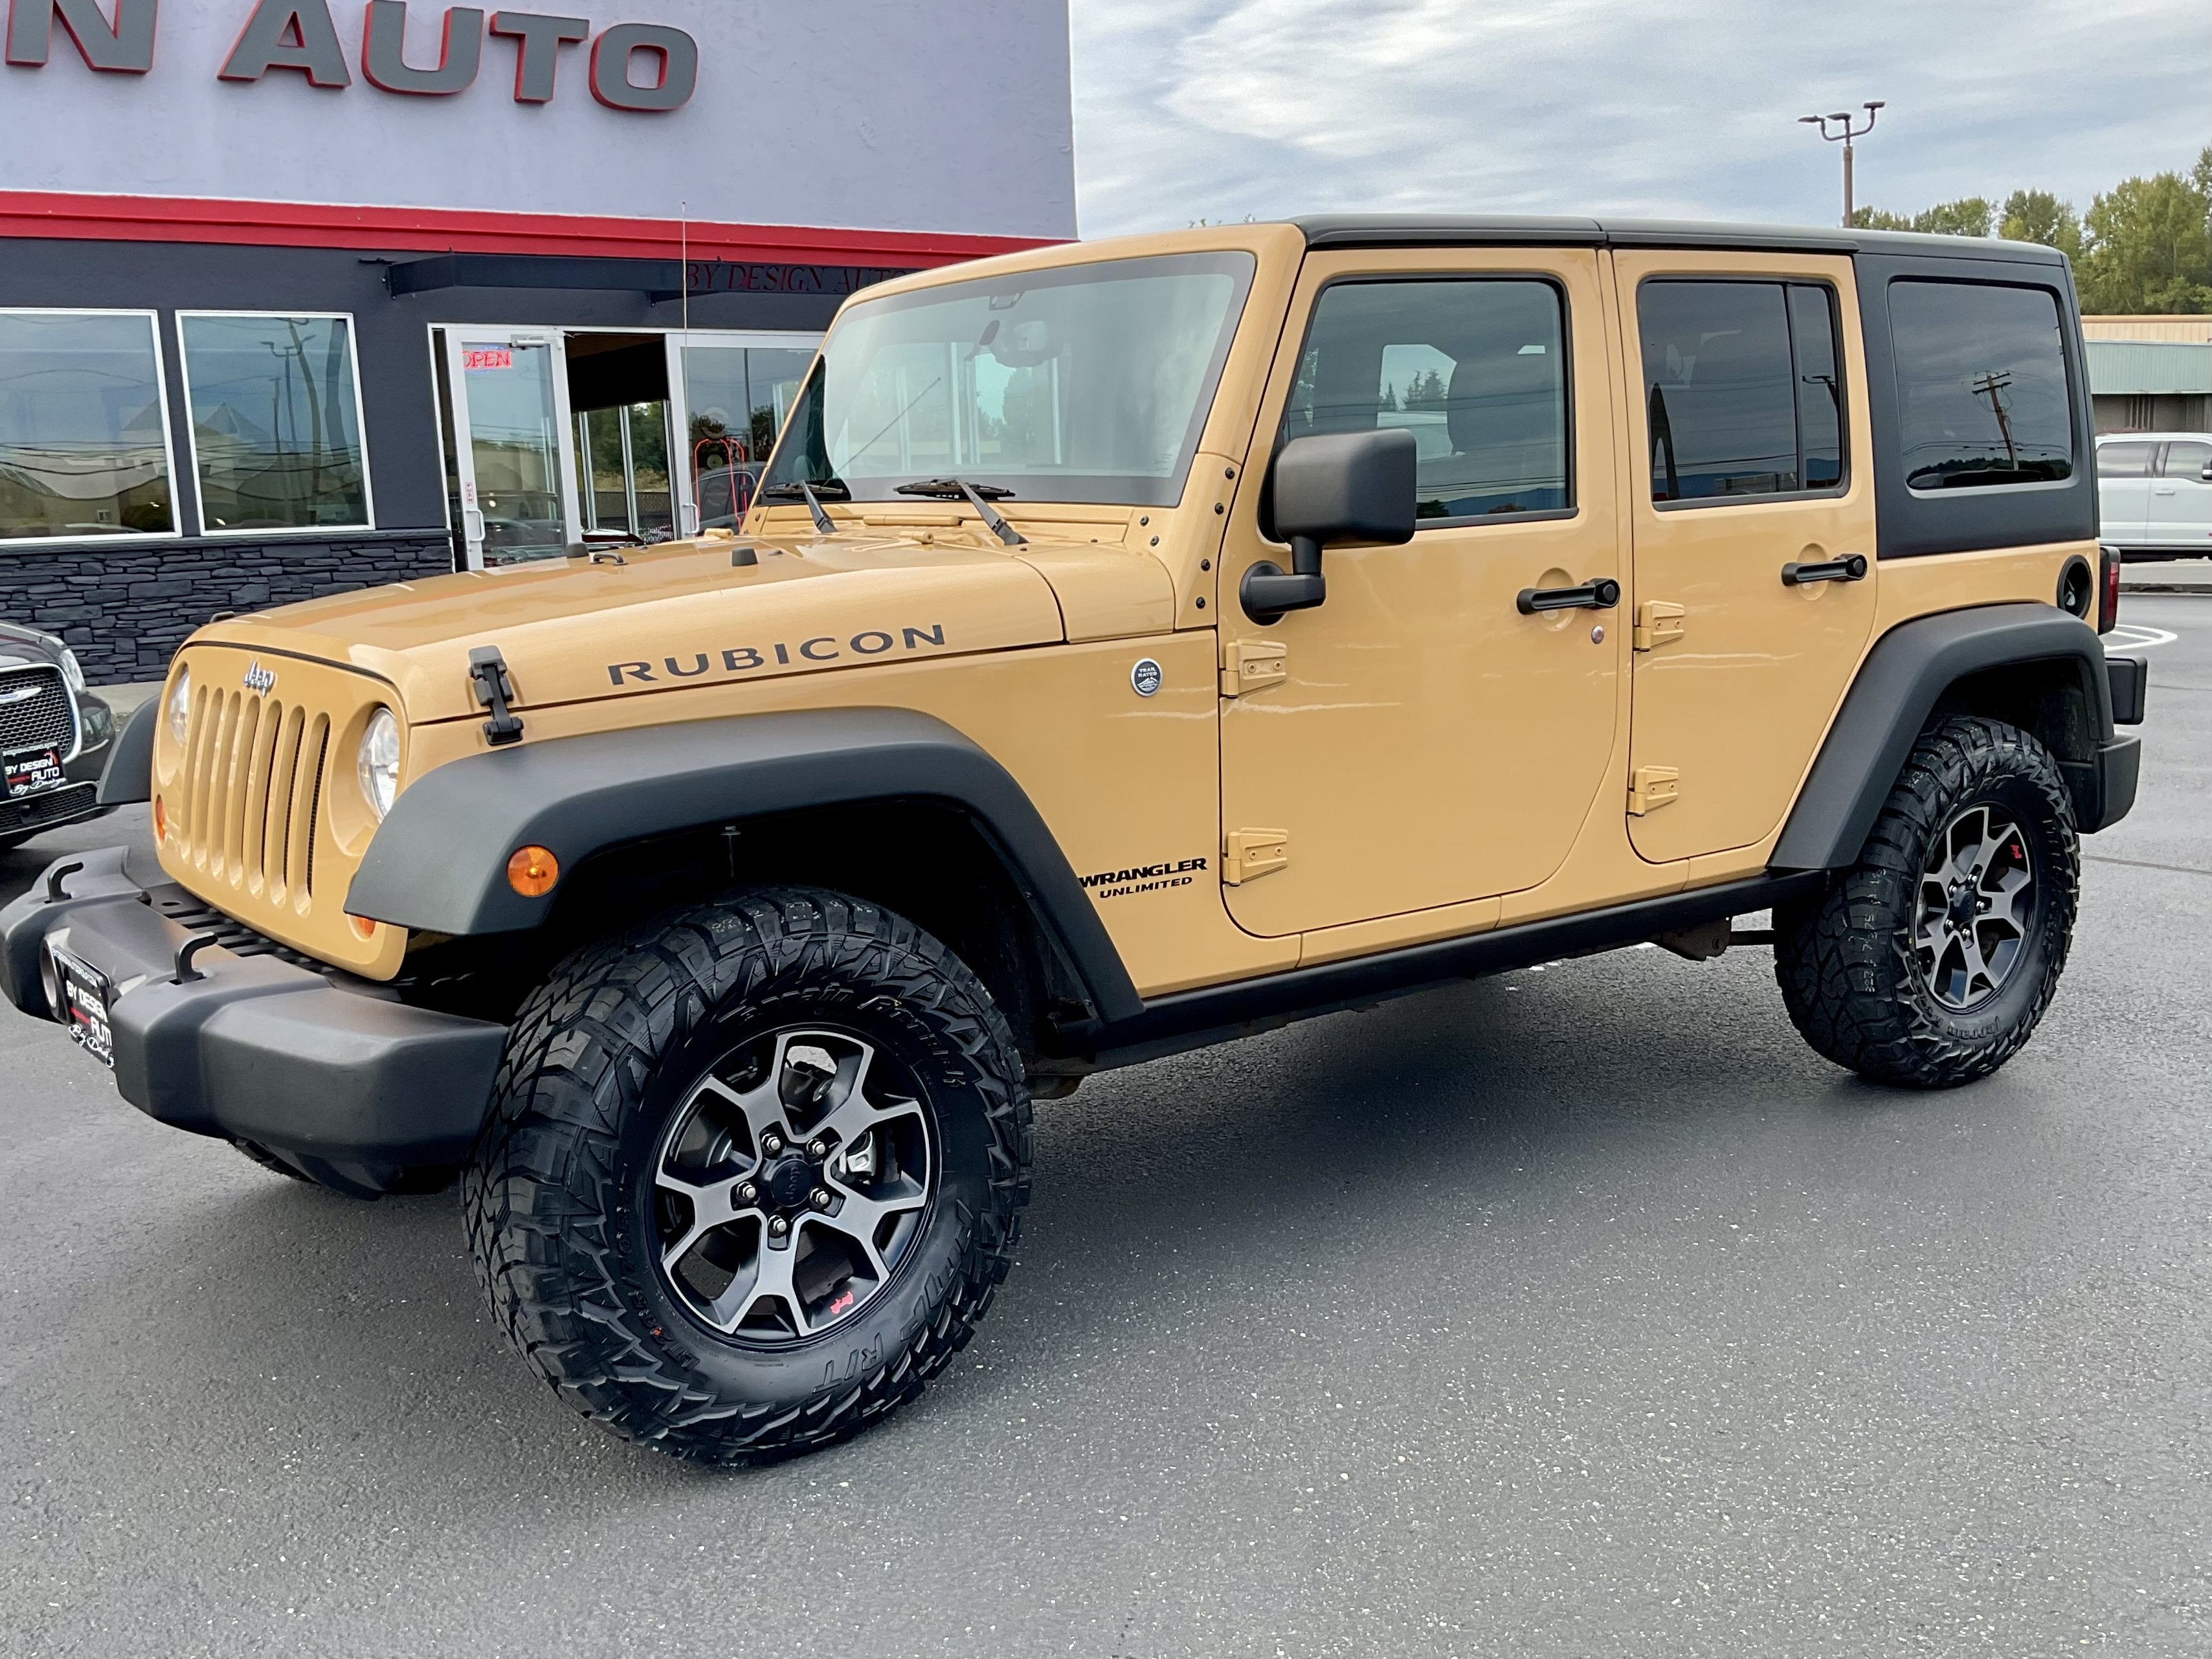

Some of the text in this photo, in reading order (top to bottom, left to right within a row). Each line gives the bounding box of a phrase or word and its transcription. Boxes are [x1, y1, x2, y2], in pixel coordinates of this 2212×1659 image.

[6, 0, 698, 111] N AUTO
[686, 263, 719, 289] BY
[728, 264, 825, 291] DESIGN
[607, 624, 945, 685] RUBICON
[244, 661, 275, 697] Jeep
[5, 757, 53, 775] BY DESIGN
[31, 766, 60, 781] AUTO
[1078, 858, 1208, 888] WRANGLER
[1099, 876, 1192, 898] UNLIMITED
[66, 979, 77, 1000] BY
[78, 988, 109, 1023] DESIGN
[90, 1016, 113, 1047] AUT
